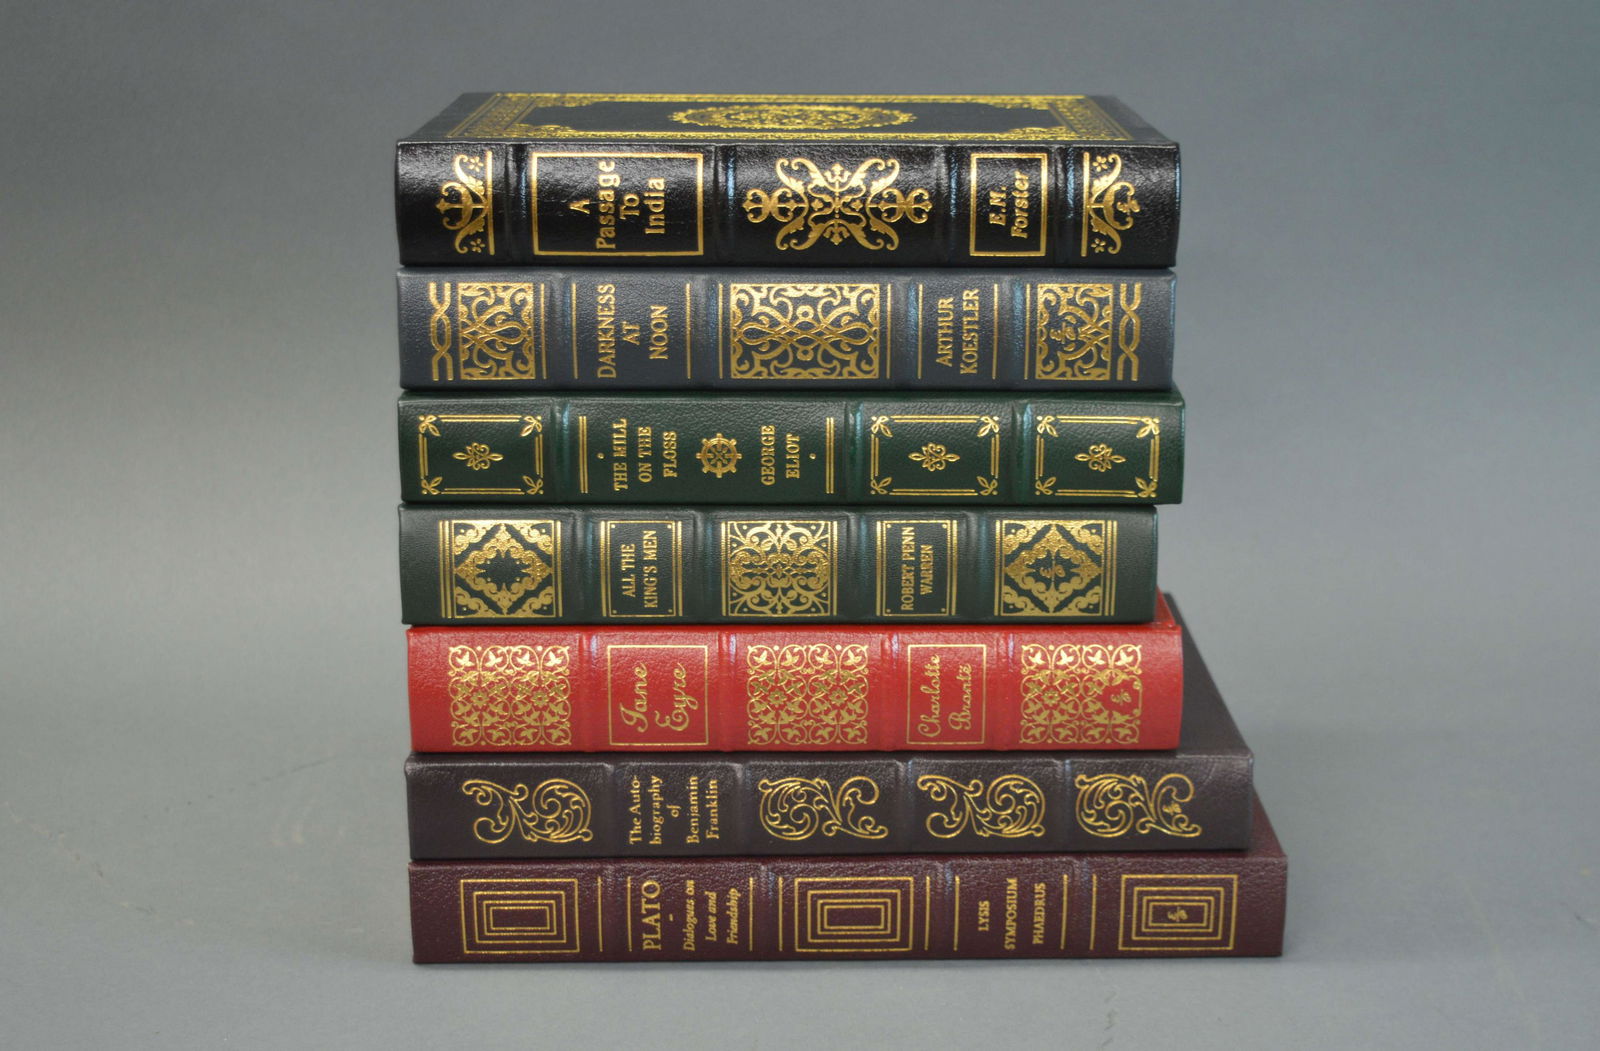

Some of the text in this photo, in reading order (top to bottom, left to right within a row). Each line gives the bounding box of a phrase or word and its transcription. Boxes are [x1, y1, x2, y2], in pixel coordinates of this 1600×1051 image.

[569, 200, 590, 215] A
[596, 160, 620, 249] Passage
[621, 193, 639, 220] To
[644, 177, 666, 235] India
[1010, 170, 1029, 239] Forster
[597, 283, 617, 379] DARKNESS
[622, 321, 640, 345] AT
[648, 304, 669, 360] NOON
[935, 296, 955, 367] ARTHUR
[959, 288, 980, 375] KOESTLER
[613, 418, 628, 492] THE MILL
[638, 426, 652, 483] ON THE
[663, 431, 678, 478] FLOSS
[761, 425, 776, 486] GEORGE
[786, 433, 800, 479] ELIOT
[621, 543, 636, 599] ALL THE
[643, 529, 659, 609] KING'S MEN
[901, 526, 916, 611] ROBERT PENN
[920, 544, 934, 596] WARREN
[619, 663, 648, 732] Jane
[654, 662, 699, 732] Eyre
[917, 654, 942, 738] Charlotte
[948, 664, 972, 731] Brontë
[629, 774, 643, 845] The Auto-
[648, 775, 664, 845] biography
[667, 804, 681, 818] of
[686, 775, 701, 844] Benjamin
[706, 779, 720, 840] Franklin
[641, 880, 662, 950] PLATO
[683, 880, 698, 951] Dialogues on
[705, 891, 718, 941] Love and
[726, 888, 741, 945] Friendship
[978, 900, 990, 931] LYSIS
[1004, 877, 1019, 950] SYMPOSIUM
[1033, 882, 1046, 945] PHAEDRUS
